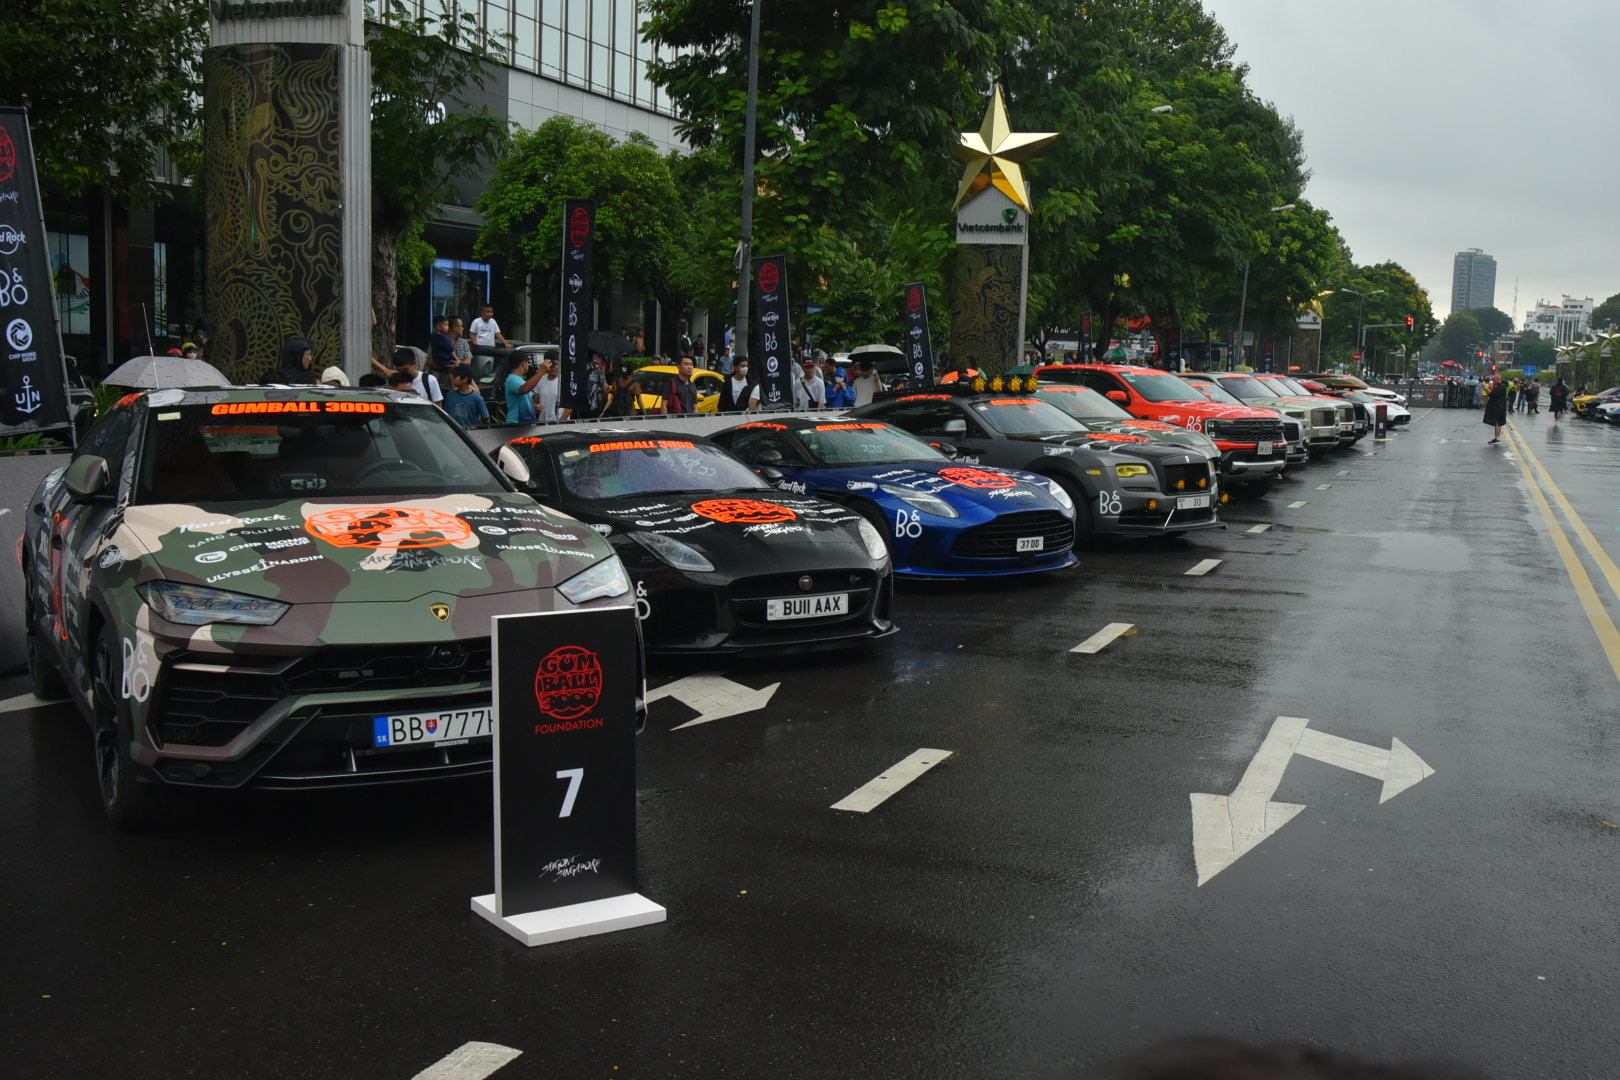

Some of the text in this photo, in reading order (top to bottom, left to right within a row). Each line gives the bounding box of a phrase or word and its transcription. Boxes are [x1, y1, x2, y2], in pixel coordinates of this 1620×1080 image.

[958, 222, 1024, 232] Vietcombank
[211, 402, 386, 416] GUMBALL 3000
[589, 440, 696, 453] GUMBALL 3000
[502, 507, 550, 520] Rock
[178, 514, 288, 534] Hard Rock
[187, 534, 225, 549] BANG
[240, 524, 301, 536] OLUFSEN
[228, 536, 310, 552] CHIP MONG
[206, 554, 325, 583] ULYSSE NARDIN
[386, 554, 483, 574] SINGAPORE
[815, 596, 841, 613] AAX
[376, 735, 387, 743] SK
[391, 716, 424, 743] BB
[535, 718, 604, 735] FOUNDATION
[556, 767, 584, 818] 7
[553, 858, 603, 883] SINGAPORE
